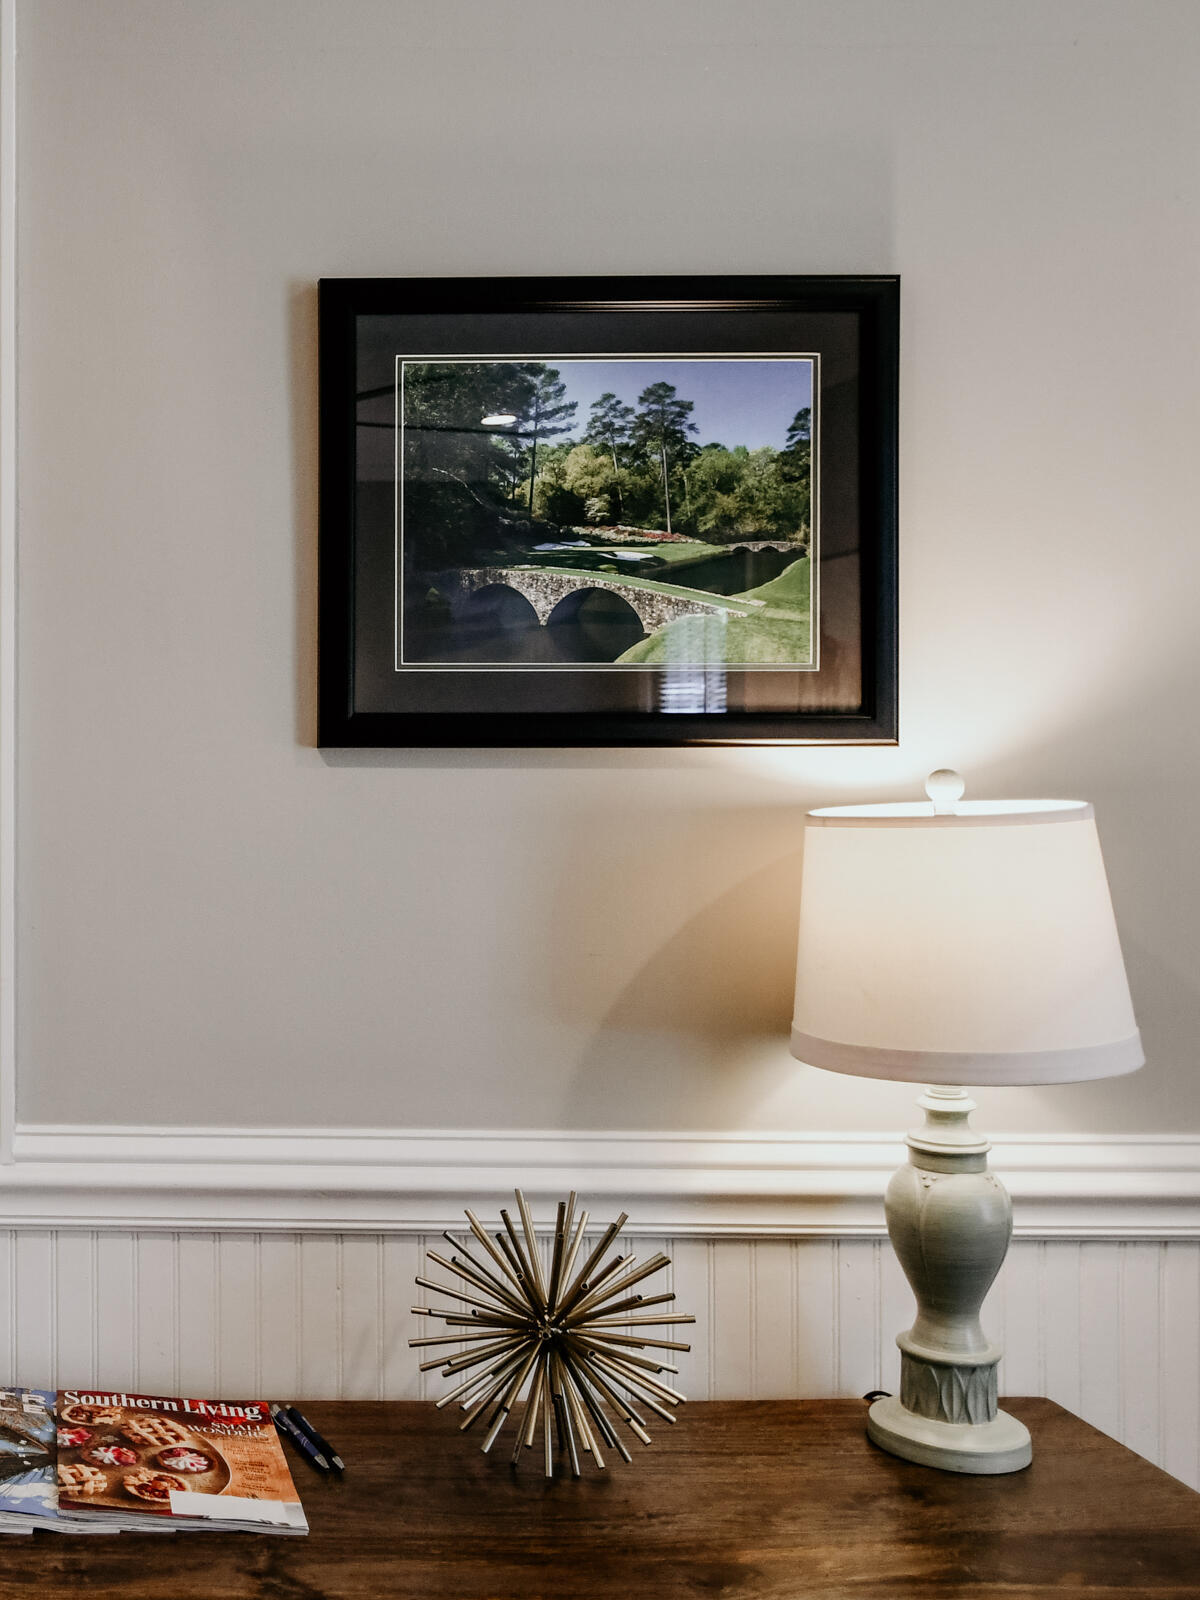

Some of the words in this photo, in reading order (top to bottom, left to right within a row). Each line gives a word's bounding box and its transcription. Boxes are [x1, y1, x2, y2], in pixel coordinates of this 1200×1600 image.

[63, 1390, 180, 1412] Southern
[182, 1398, 263, 1422] Living
[187, 1424, 269, 1438] WONDERS
